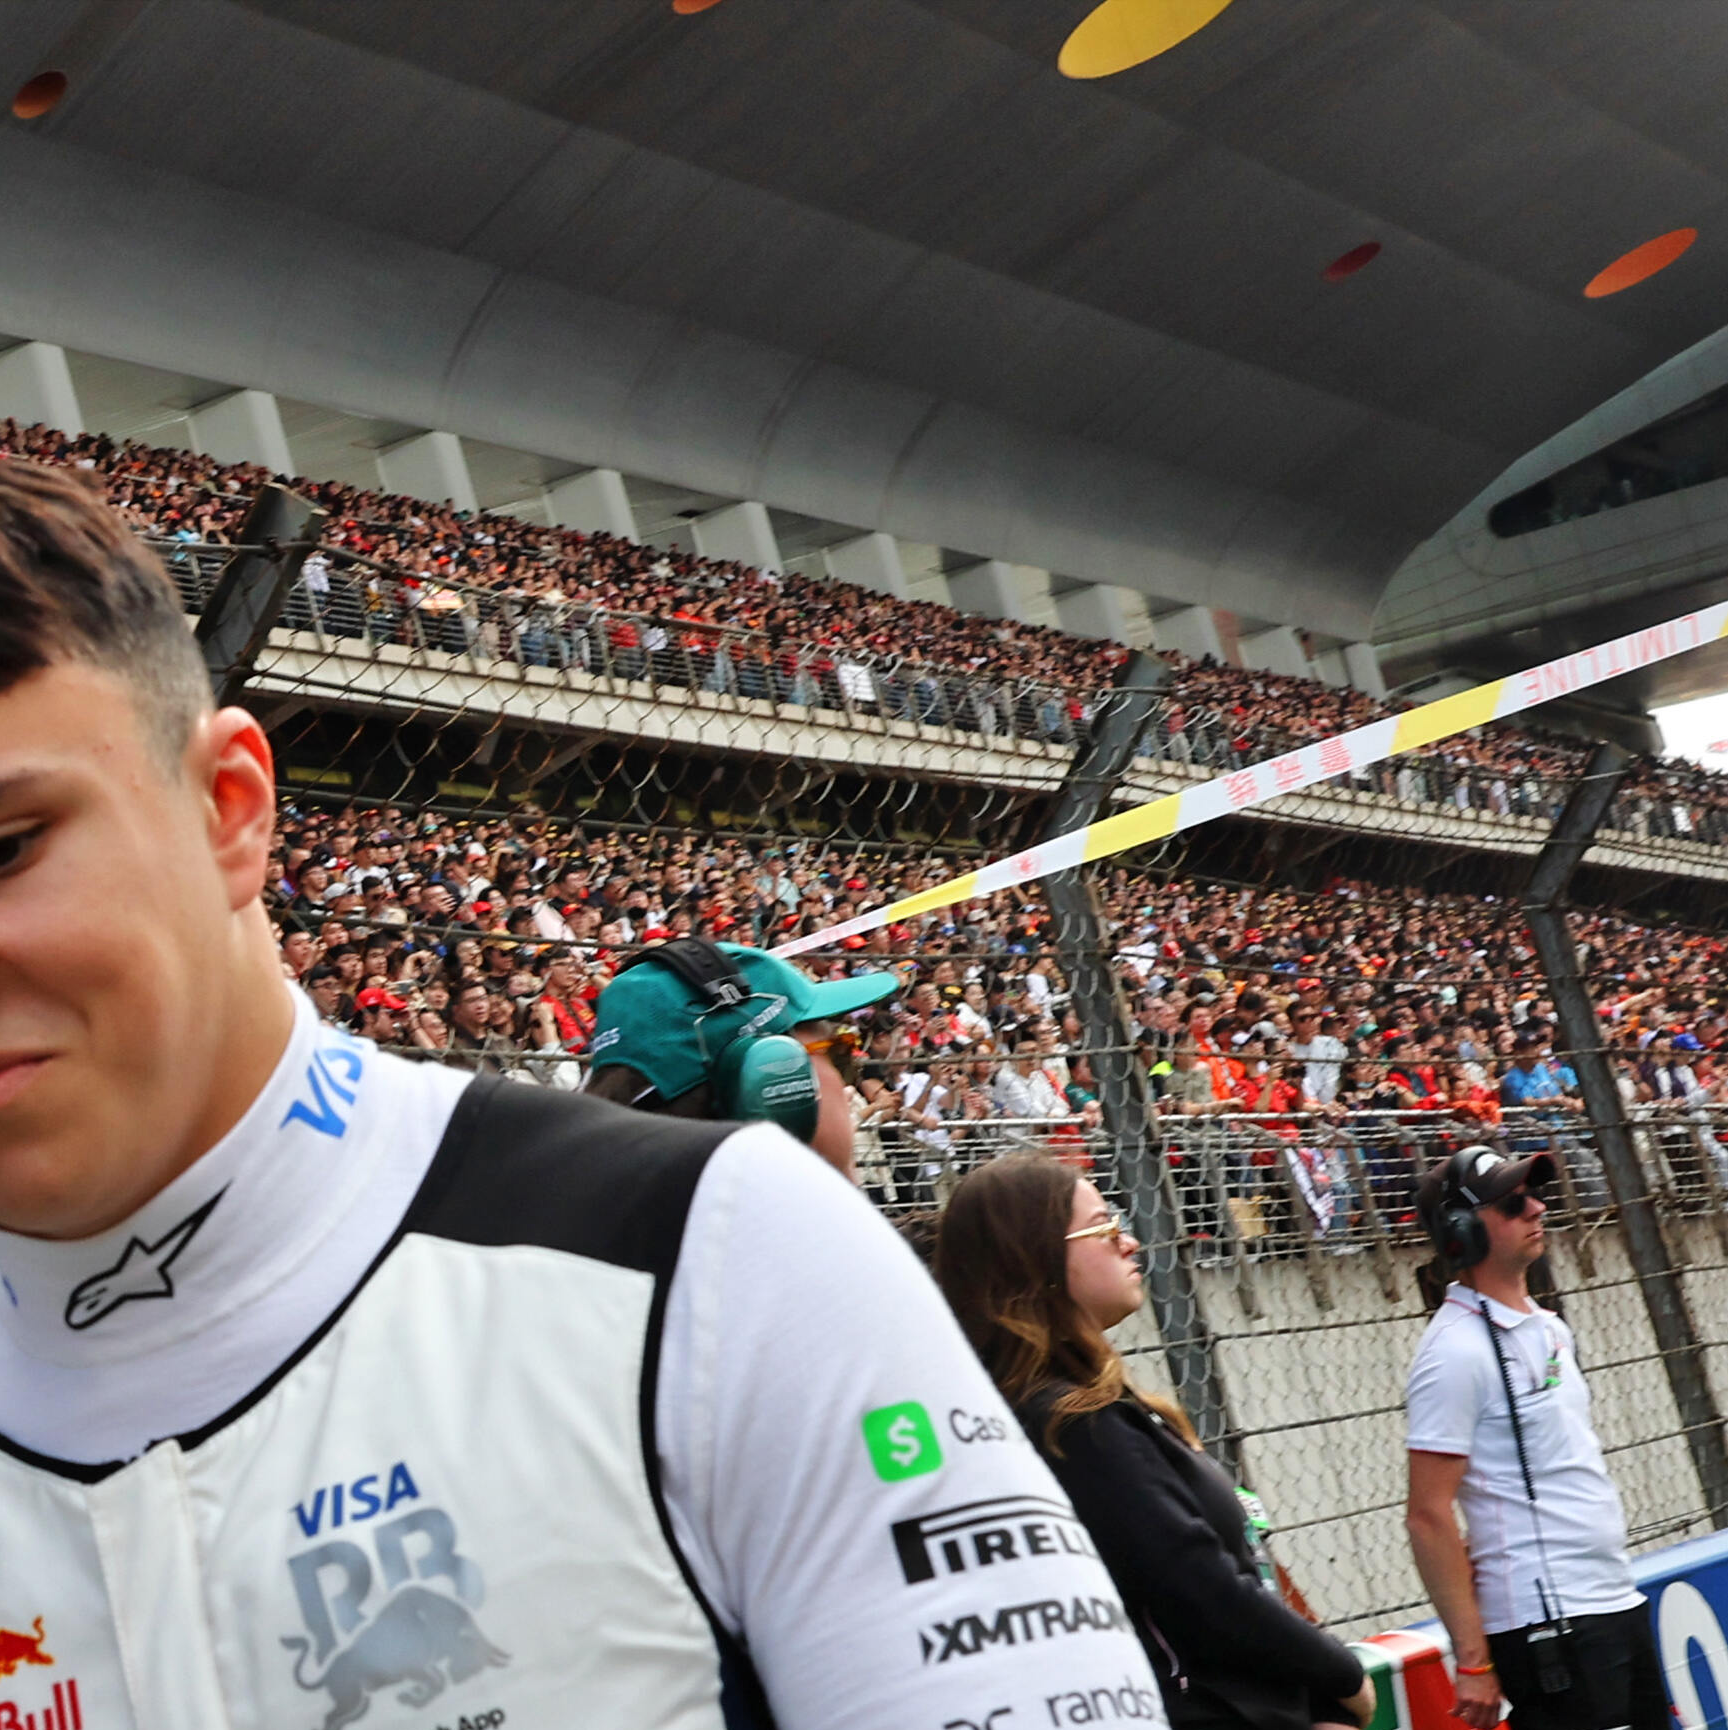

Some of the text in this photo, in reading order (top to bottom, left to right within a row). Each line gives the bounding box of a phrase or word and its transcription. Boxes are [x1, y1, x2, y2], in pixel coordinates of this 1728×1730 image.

[280, 1034, 363, 1139] VIS
[289, 1461, 421, 1538] VISA
[1046, 1675, 1157, 1728] rands
